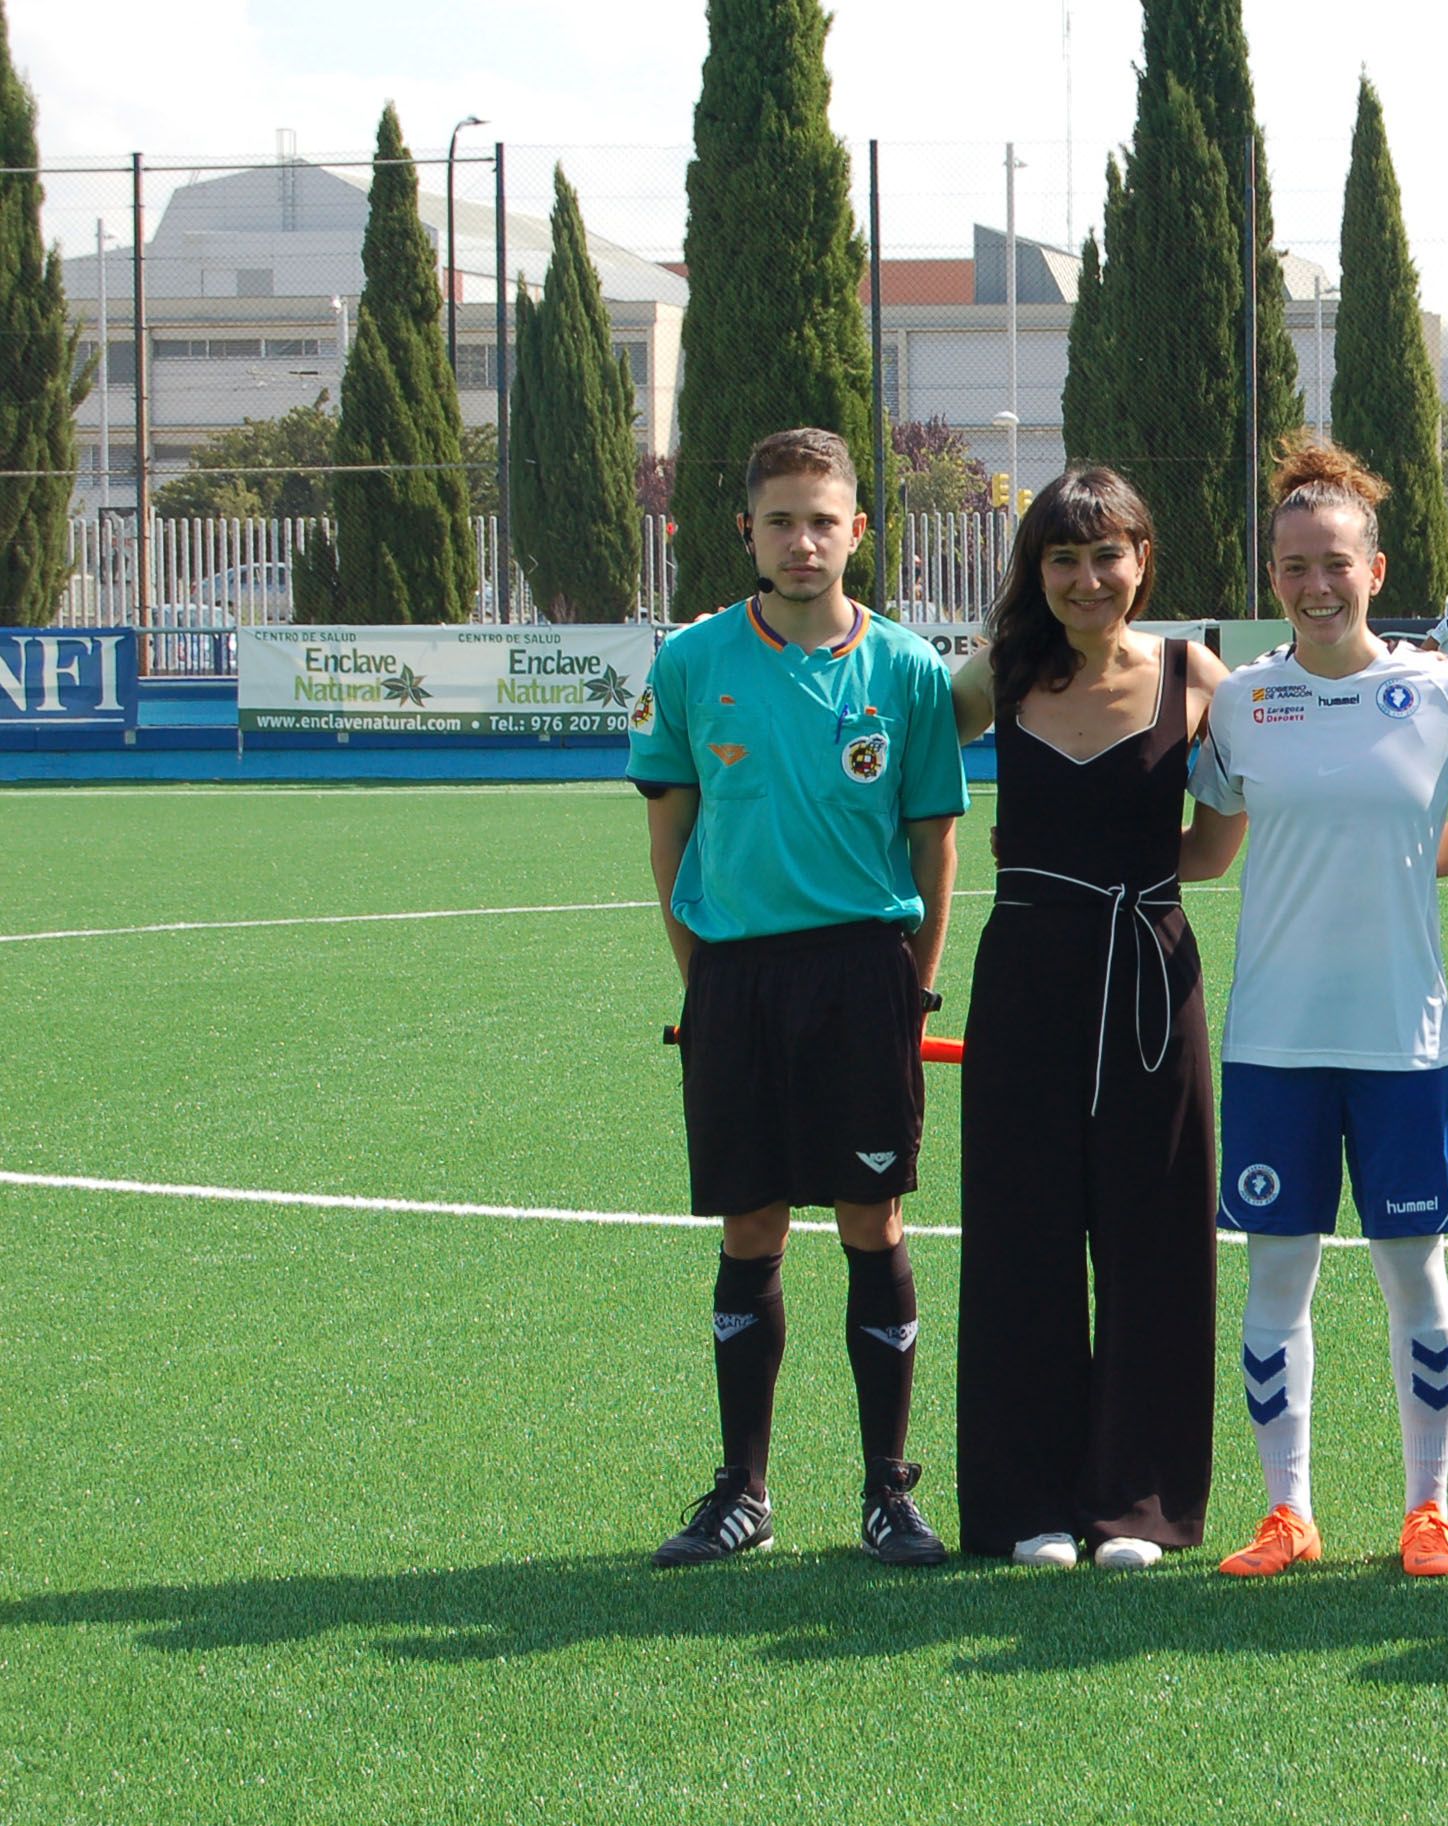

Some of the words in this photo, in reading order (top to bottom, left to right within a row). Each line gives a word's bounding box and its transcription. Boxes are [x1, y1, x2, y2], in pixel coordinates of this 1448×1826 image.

[255, 632, 298, 642] CENTRO
[302, 633, 316, 642] DE
[320, 632, 357, 642] SALUD
[458, 633, 502, 643] CENTRO
[506, 634, 520, 644] DE
[524, 634, 561, 644] SALUD
[306, 648, 397, 673] Enclave
[509, 649, 601, 675] Enclave
[294, 675, 382, 701] Natural
[497, 678, 584, 704] Natural
[1318, 694, 1360, 707] hummel
[256, 714, 460, 731] www.enclavenatural.com
[490, 716, 525, 731] Tel.:
[531, 716, 563, 731] 976
[569, 716, 599, 731] 207
[1386, 1196, 1438, 1214] hummel
